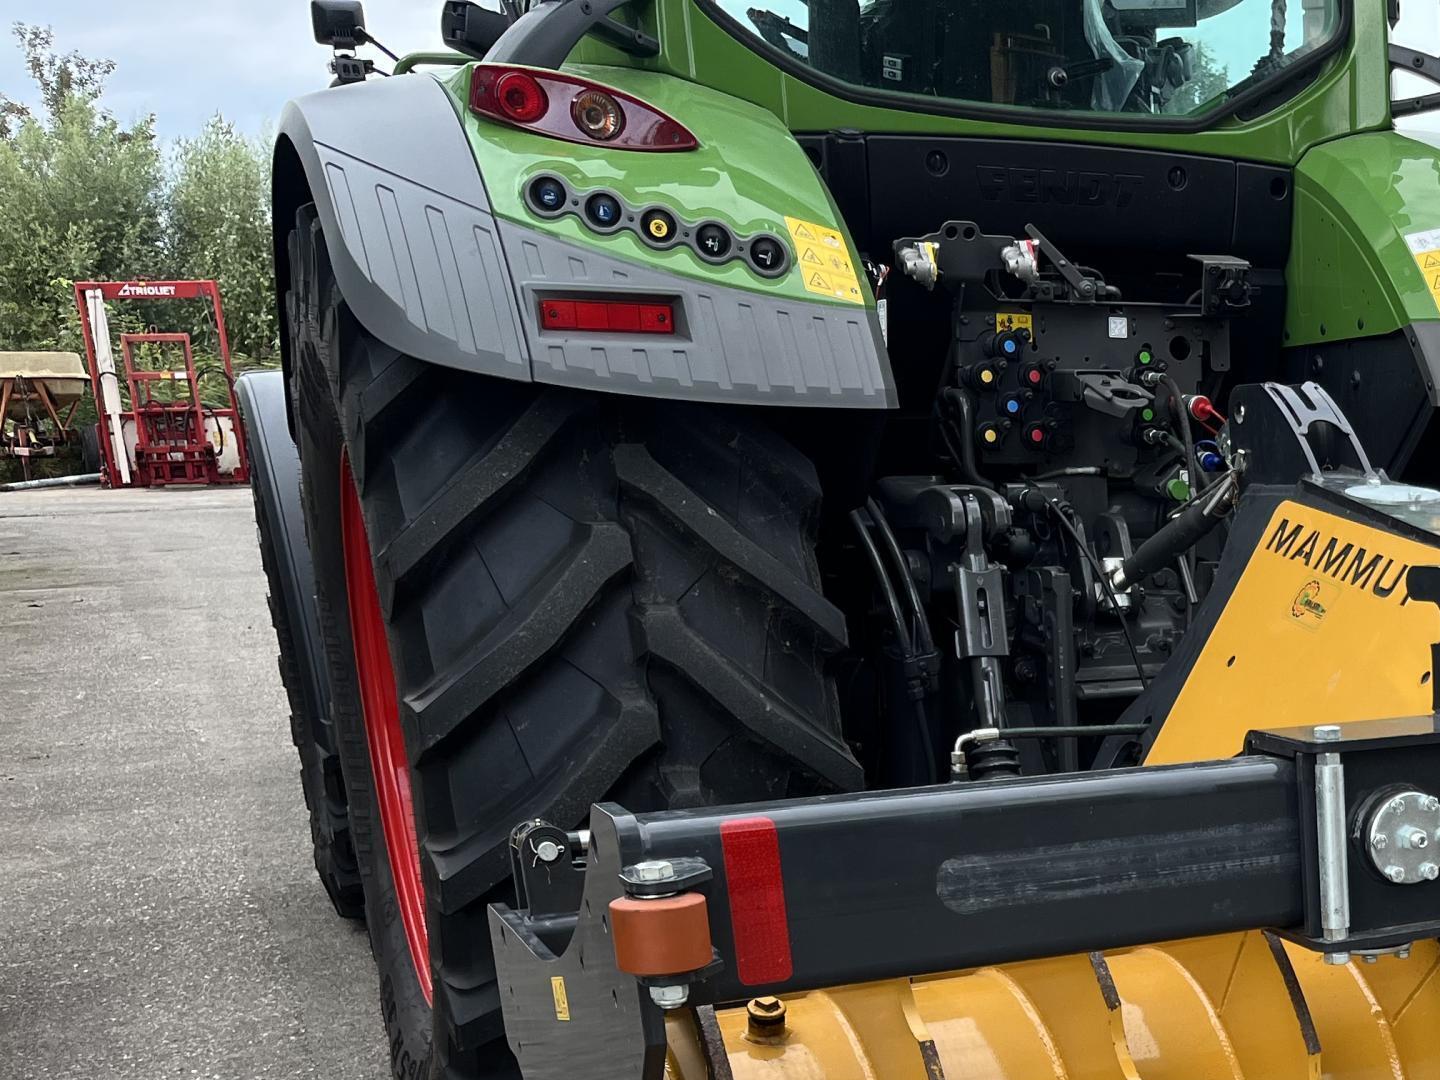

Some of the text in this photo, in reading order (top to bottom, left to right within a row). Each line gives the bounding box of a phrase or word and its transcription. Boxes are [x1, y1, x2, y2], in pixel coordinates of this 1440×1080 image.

[976, 165, 1145, 208] FENDT
[130, 286, 176, 296] TRIOLIET
[1266, 518, 1411, 607] MAMMU
